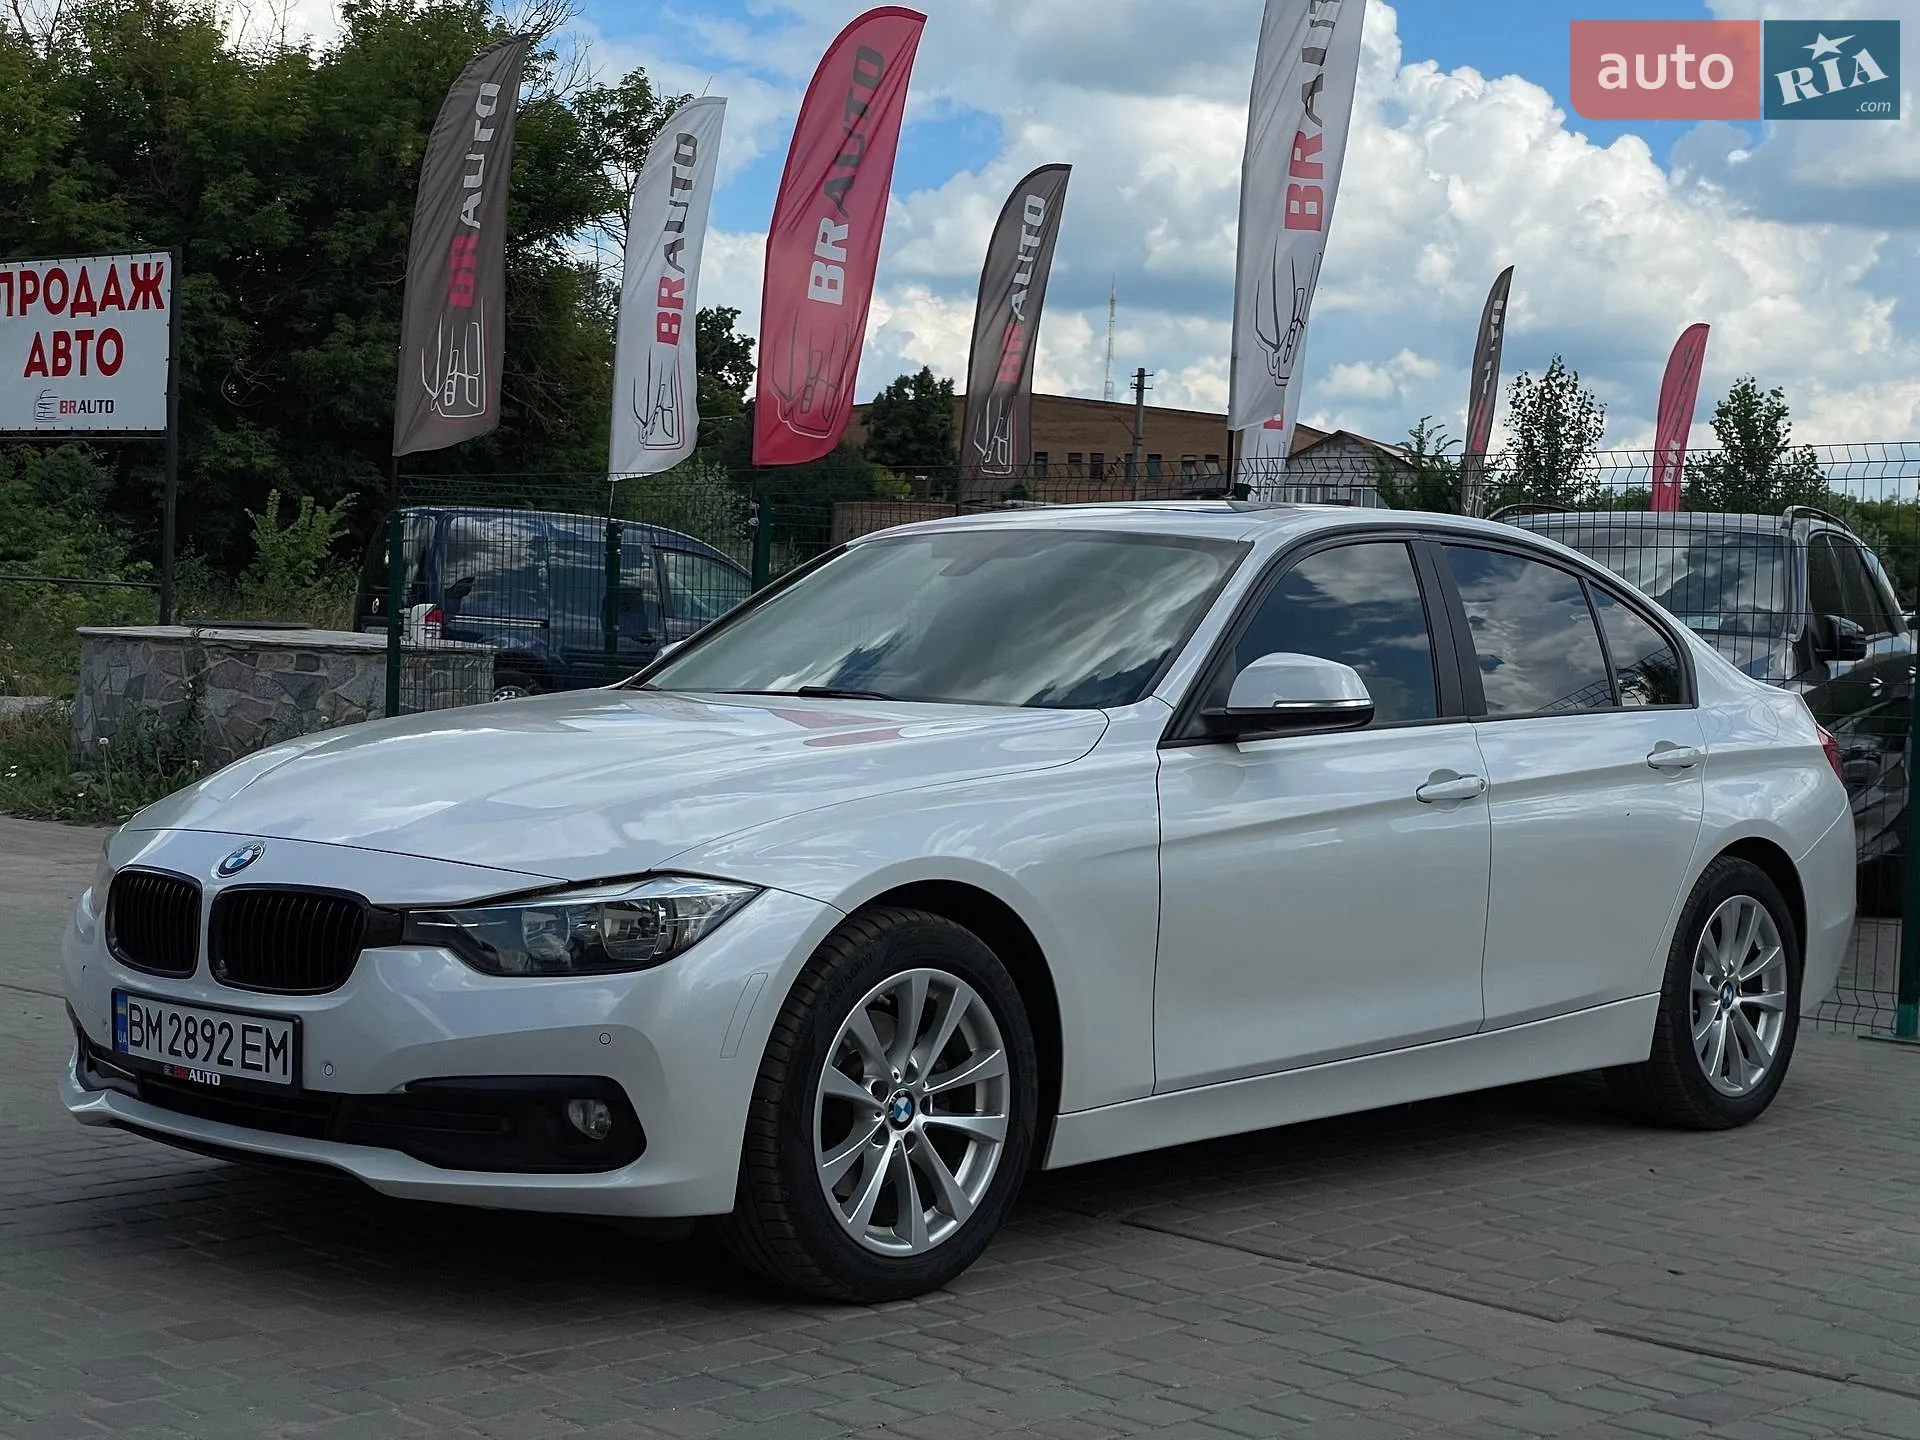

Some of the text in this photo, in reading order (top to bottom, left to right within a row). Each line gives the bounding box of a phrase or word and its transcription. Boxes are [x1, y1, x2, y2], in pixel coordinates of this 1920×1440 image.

[808, 44, 885, 305] BRAUTO
[656, 132, 698, 346] BRAUTO
[23, 327, 124, 378] АВТО
[59, 399, 114, 414] BRAUTO
[117, 1031, 127, 1044] UA
[129, 1002, 288, 1076] BM 2892 EM
